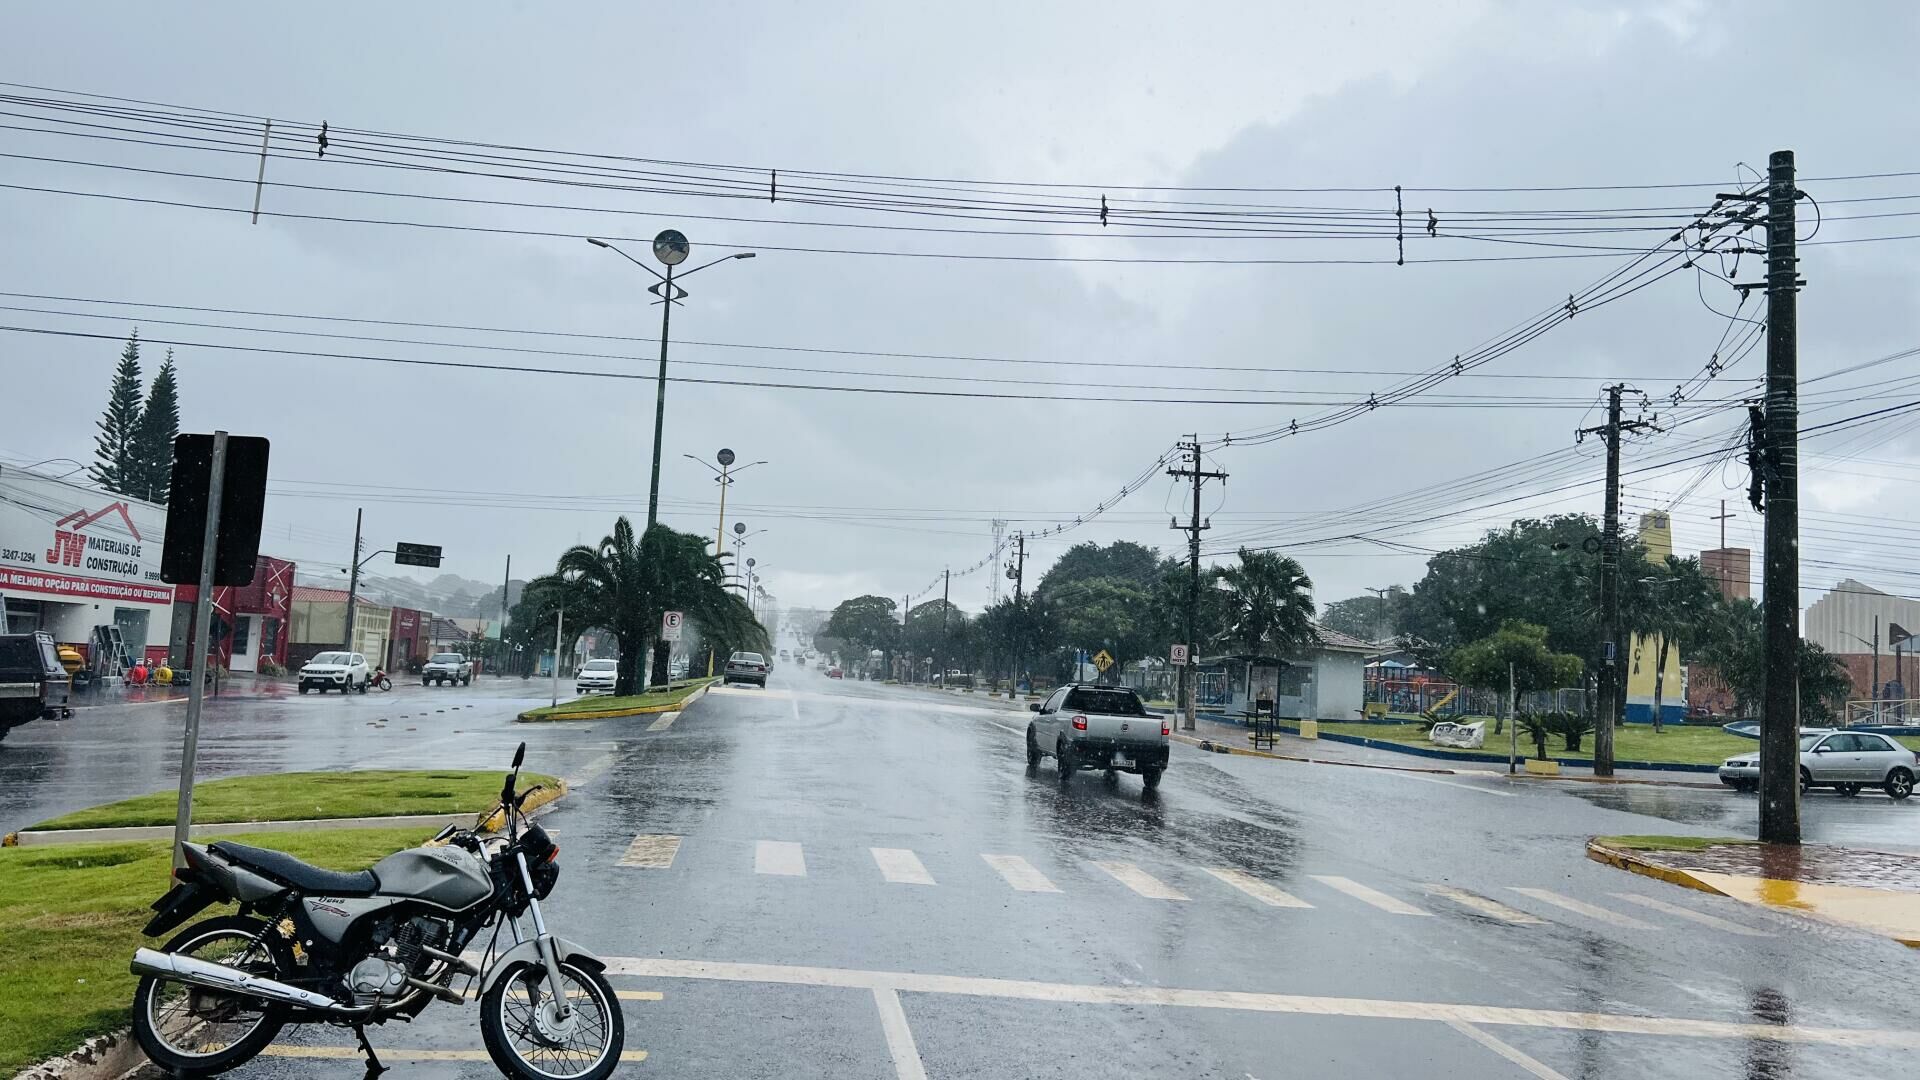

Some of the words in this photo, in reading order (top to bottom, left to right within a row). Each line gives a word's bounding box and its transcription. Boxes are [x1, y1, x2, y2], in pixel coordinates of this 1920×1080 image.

[2, 549, 35, 563] 3247-1294
[46, 530, 86, 567] JW
[88, 537, 130, 555] MATERIAIS
[131, 545, 141, 557] DE
[86, 557, 138, 577] CONSTRUÇÃO
[10, 574, 43, 587] MELHOR
[45, 578, 70, 592] OPÇÃO
[71, 582, 89, 592] PARA
[91, 584, 132, 598] CONSTRUÇÃO
[143, 589, 170, 600] REFORMA
[670, 615, 676, 625] E
